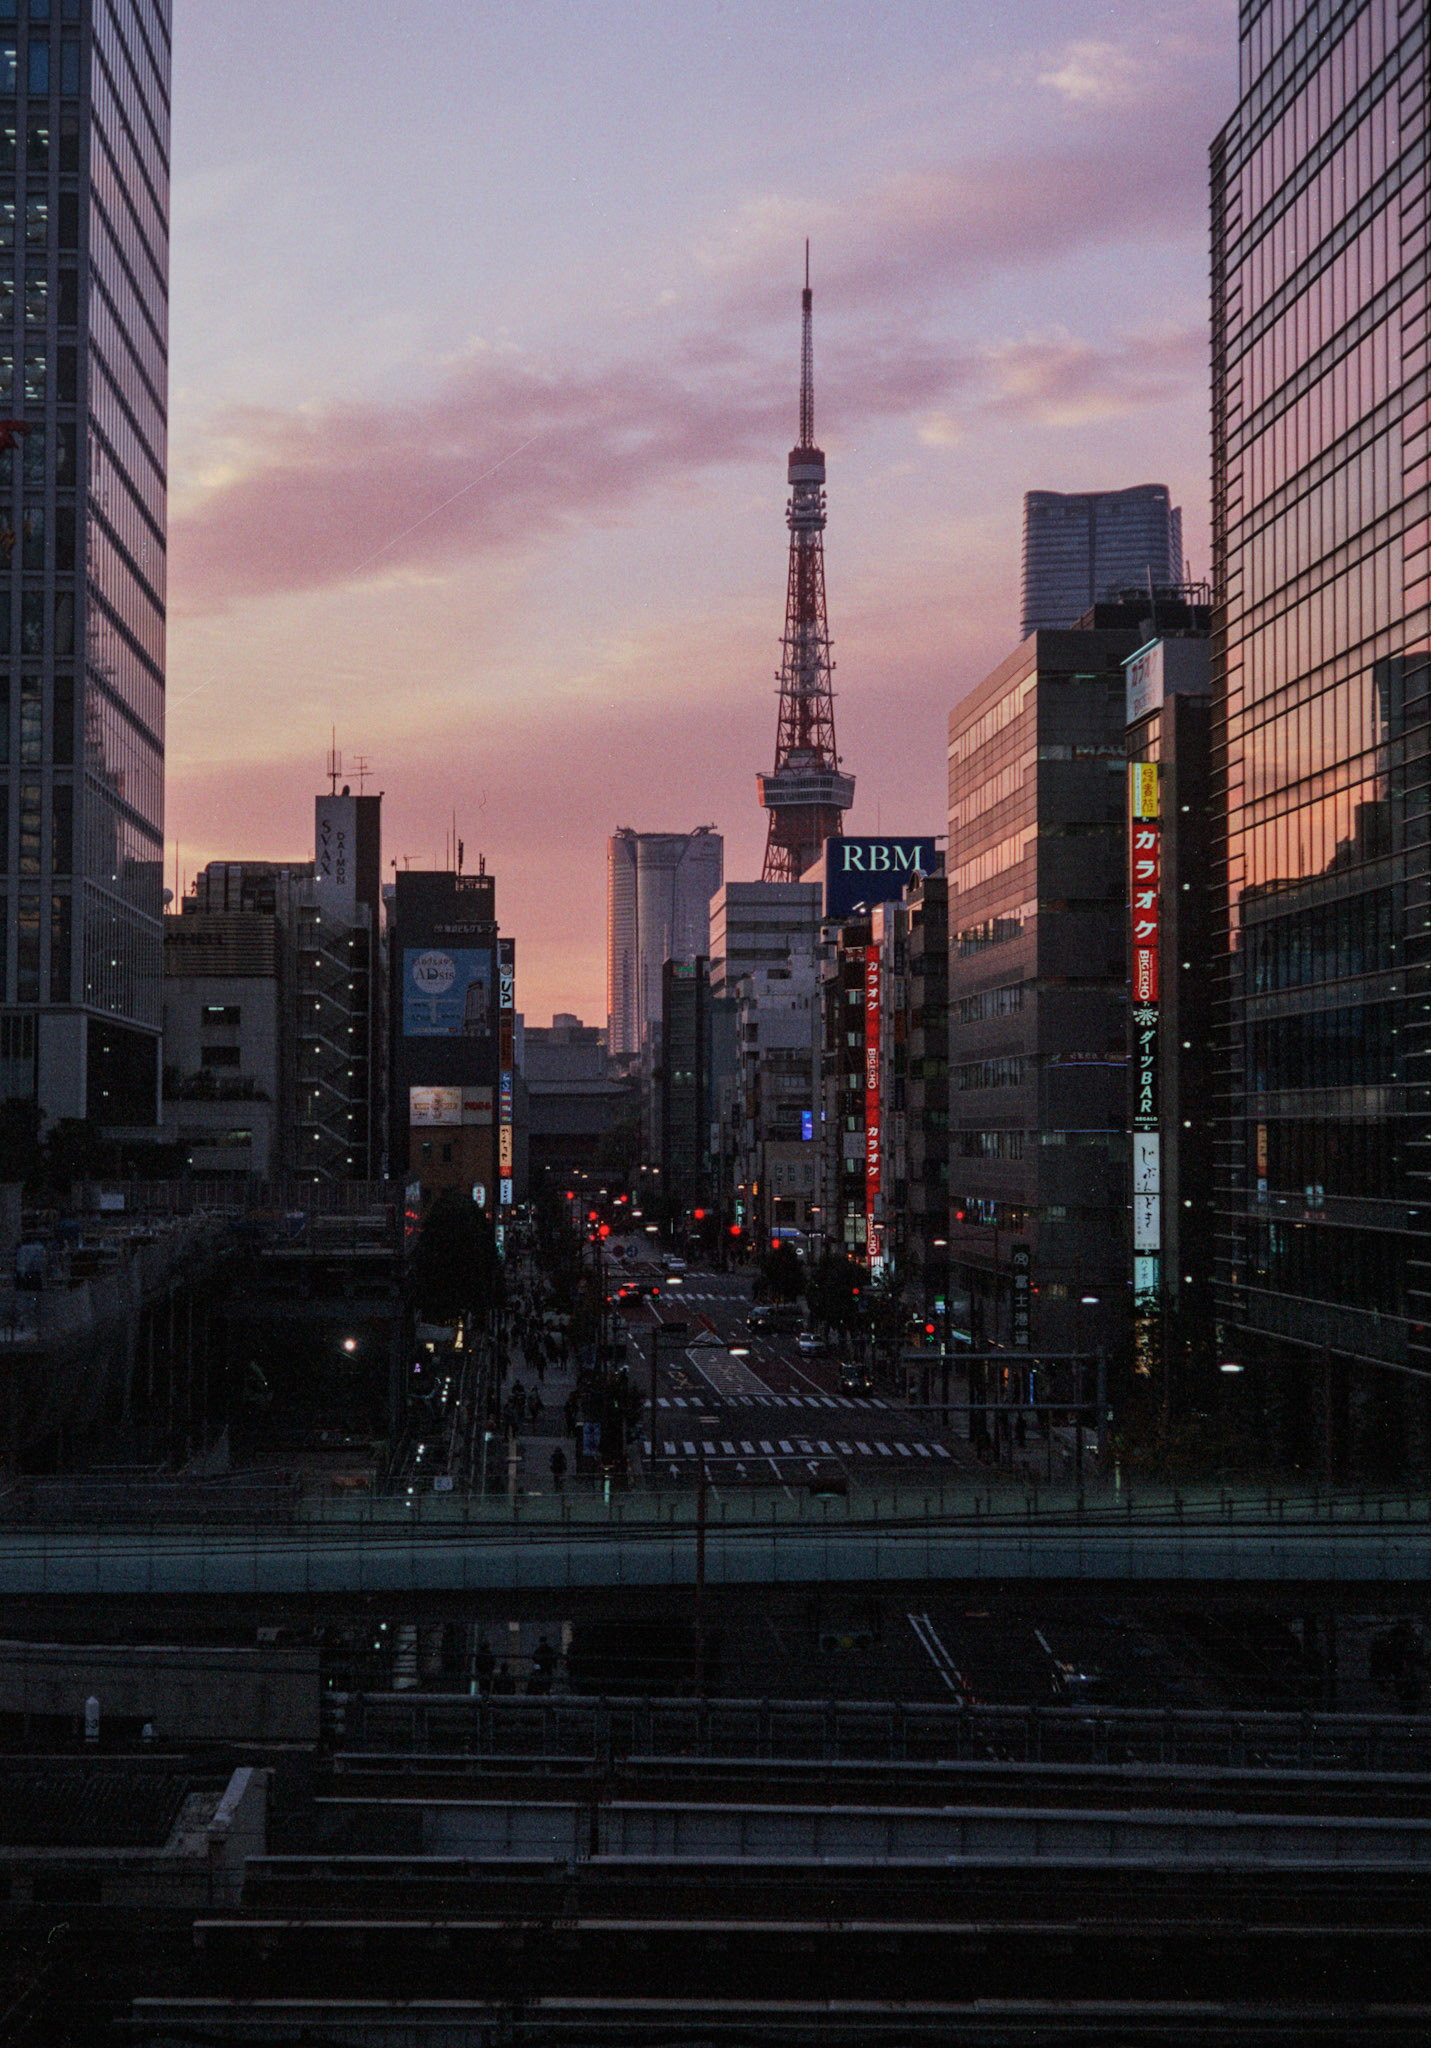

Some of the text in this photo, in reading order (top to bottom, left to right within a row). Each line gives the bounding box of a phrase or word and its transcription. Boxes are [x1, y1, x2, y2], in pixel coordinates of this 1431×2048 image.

[320, 820, 332, 876] SVAX
[336, 832, 345, 885] DAIMON
[841, 845, 923, 871] RBM
[1134, 830, 1157, 939] カラオケ
[867, 962, 879, 1011] カラオケ
[1139, 950, 1150, 999] BIG ECHO
[867, 1068, 877, 1089] ECHO
[1139, 1029, 1156, 1113] ダーツ BAR
[867, 1127, 880, 1176] カラオケ
